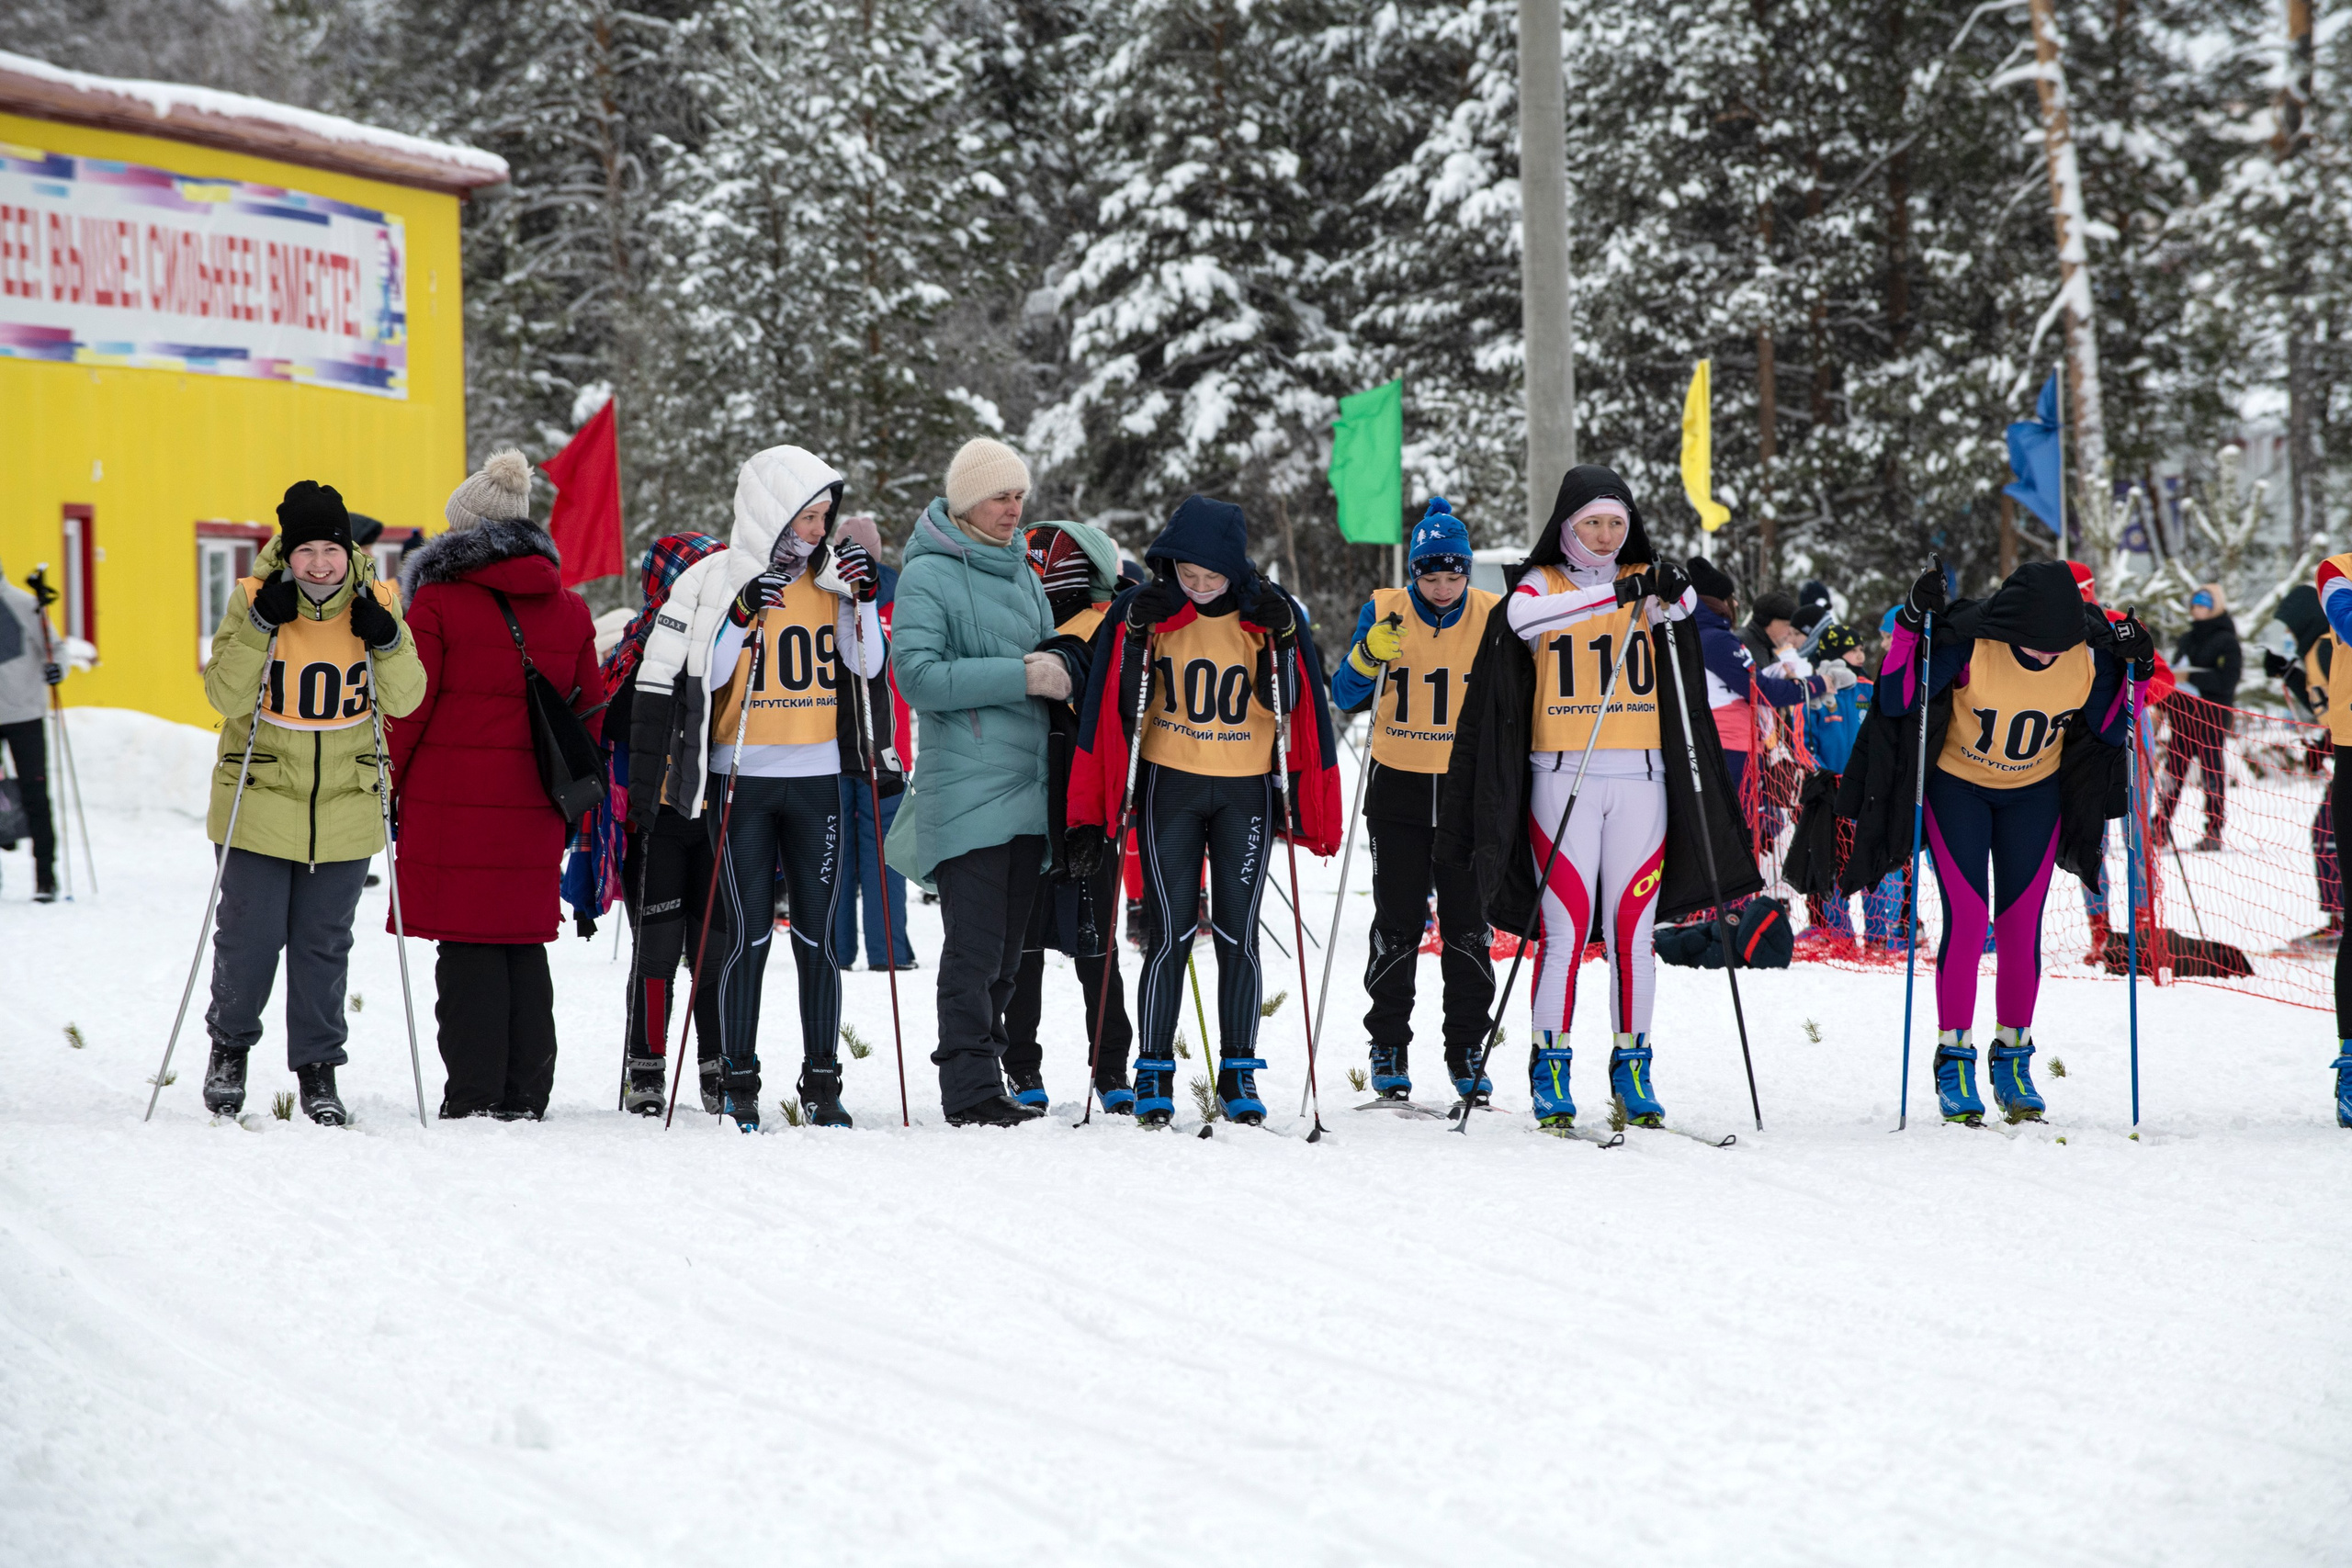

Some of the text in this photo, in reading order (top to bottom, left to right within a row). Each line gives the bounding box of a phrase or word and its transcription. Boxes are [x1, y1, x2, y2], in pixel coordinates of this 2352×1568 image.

[49, 212, 141, 309] ВЫШЕ!
[147, 224, 263, 323] СИЛЬНЕЕ!
[266, 240, 361, 339] ВМЕСТЕ!
[741, 624, 836, 694] 109
[1548, 630, 1655, 698] 110
[270, 660, 369, 719] 103
[816, 694, 838, 706] РАЙО
[1155, 656, 1252, 726] 100
[1547, 701, 1656, 716] СУРГУТСИЙ РАЙОН
[1152, 716, 1251, 741] СУРГУТСКИЙ РАЙОН
[1385, 725, 1454, 741] СУРГУТСКИЙ
[1961, 746, 2033, 772] СУРГУТСКИЙ
[1370, 837, 1379, 875] VITZHEN
